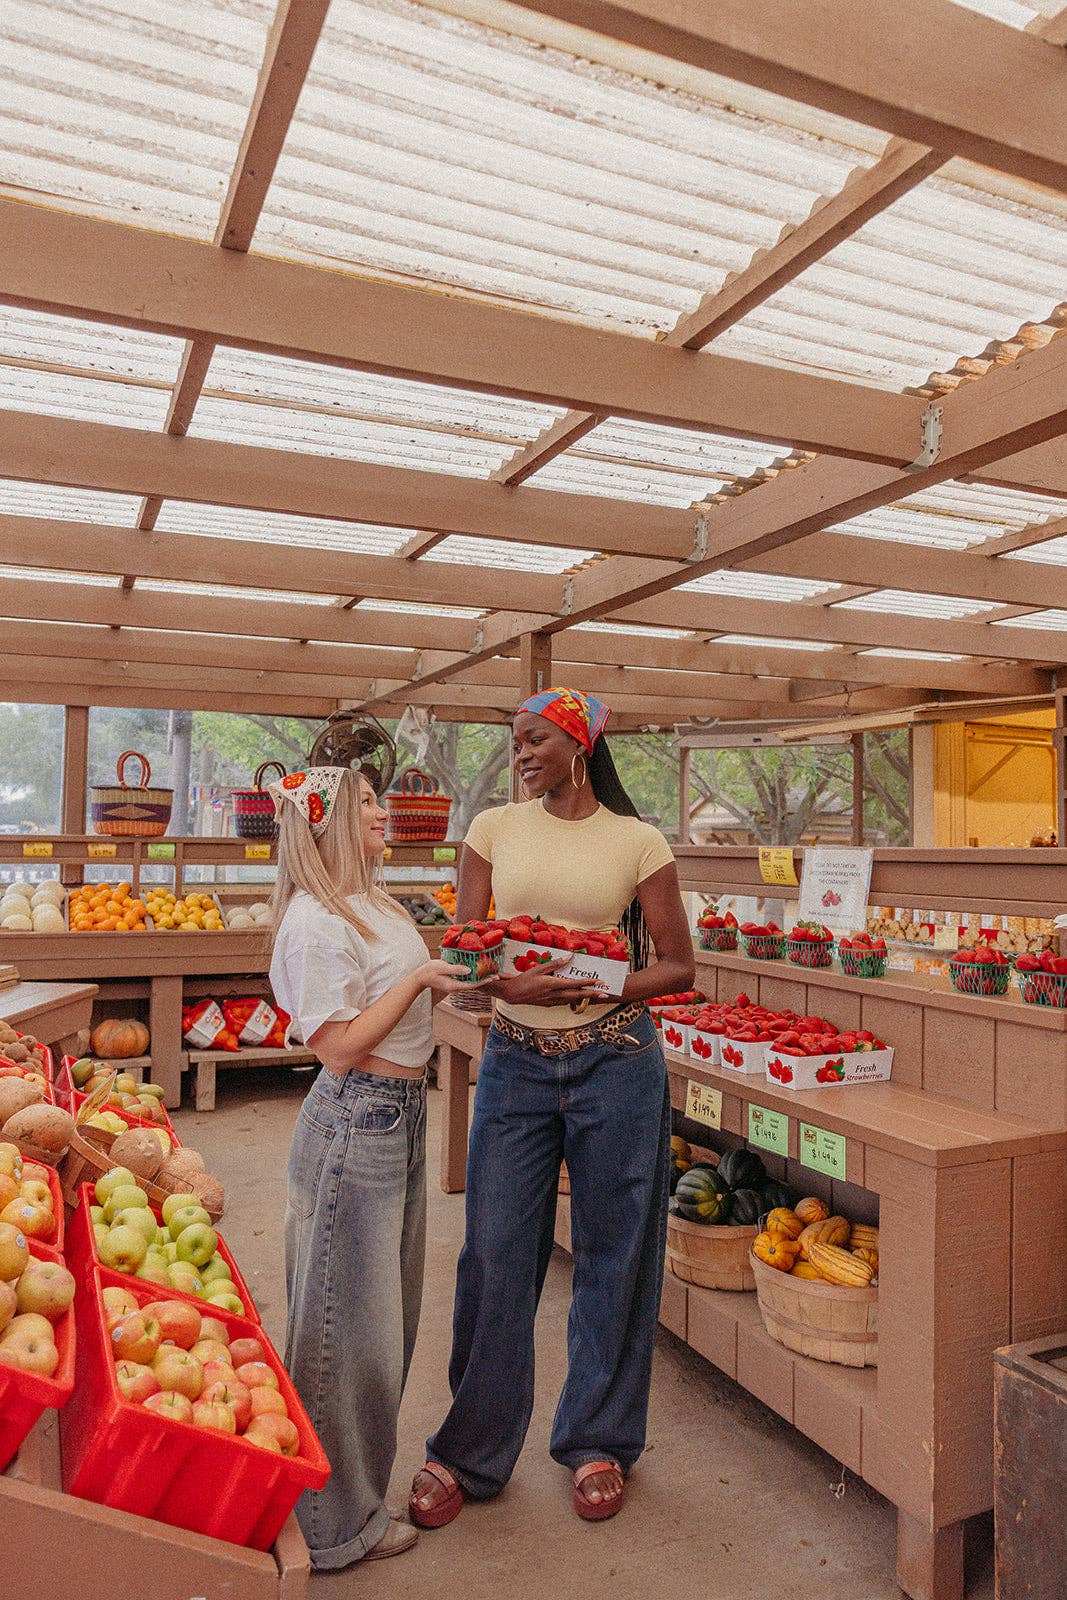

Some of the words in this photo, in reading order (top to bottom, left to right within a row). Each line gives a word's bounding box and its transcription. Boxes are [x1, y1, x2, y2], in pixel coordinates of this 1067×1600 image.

[569, 966, 599, 979] Fresh
[855, 1063, 877, 1073] Fresh
[847, 1072, 883, 1080] Strawberries
